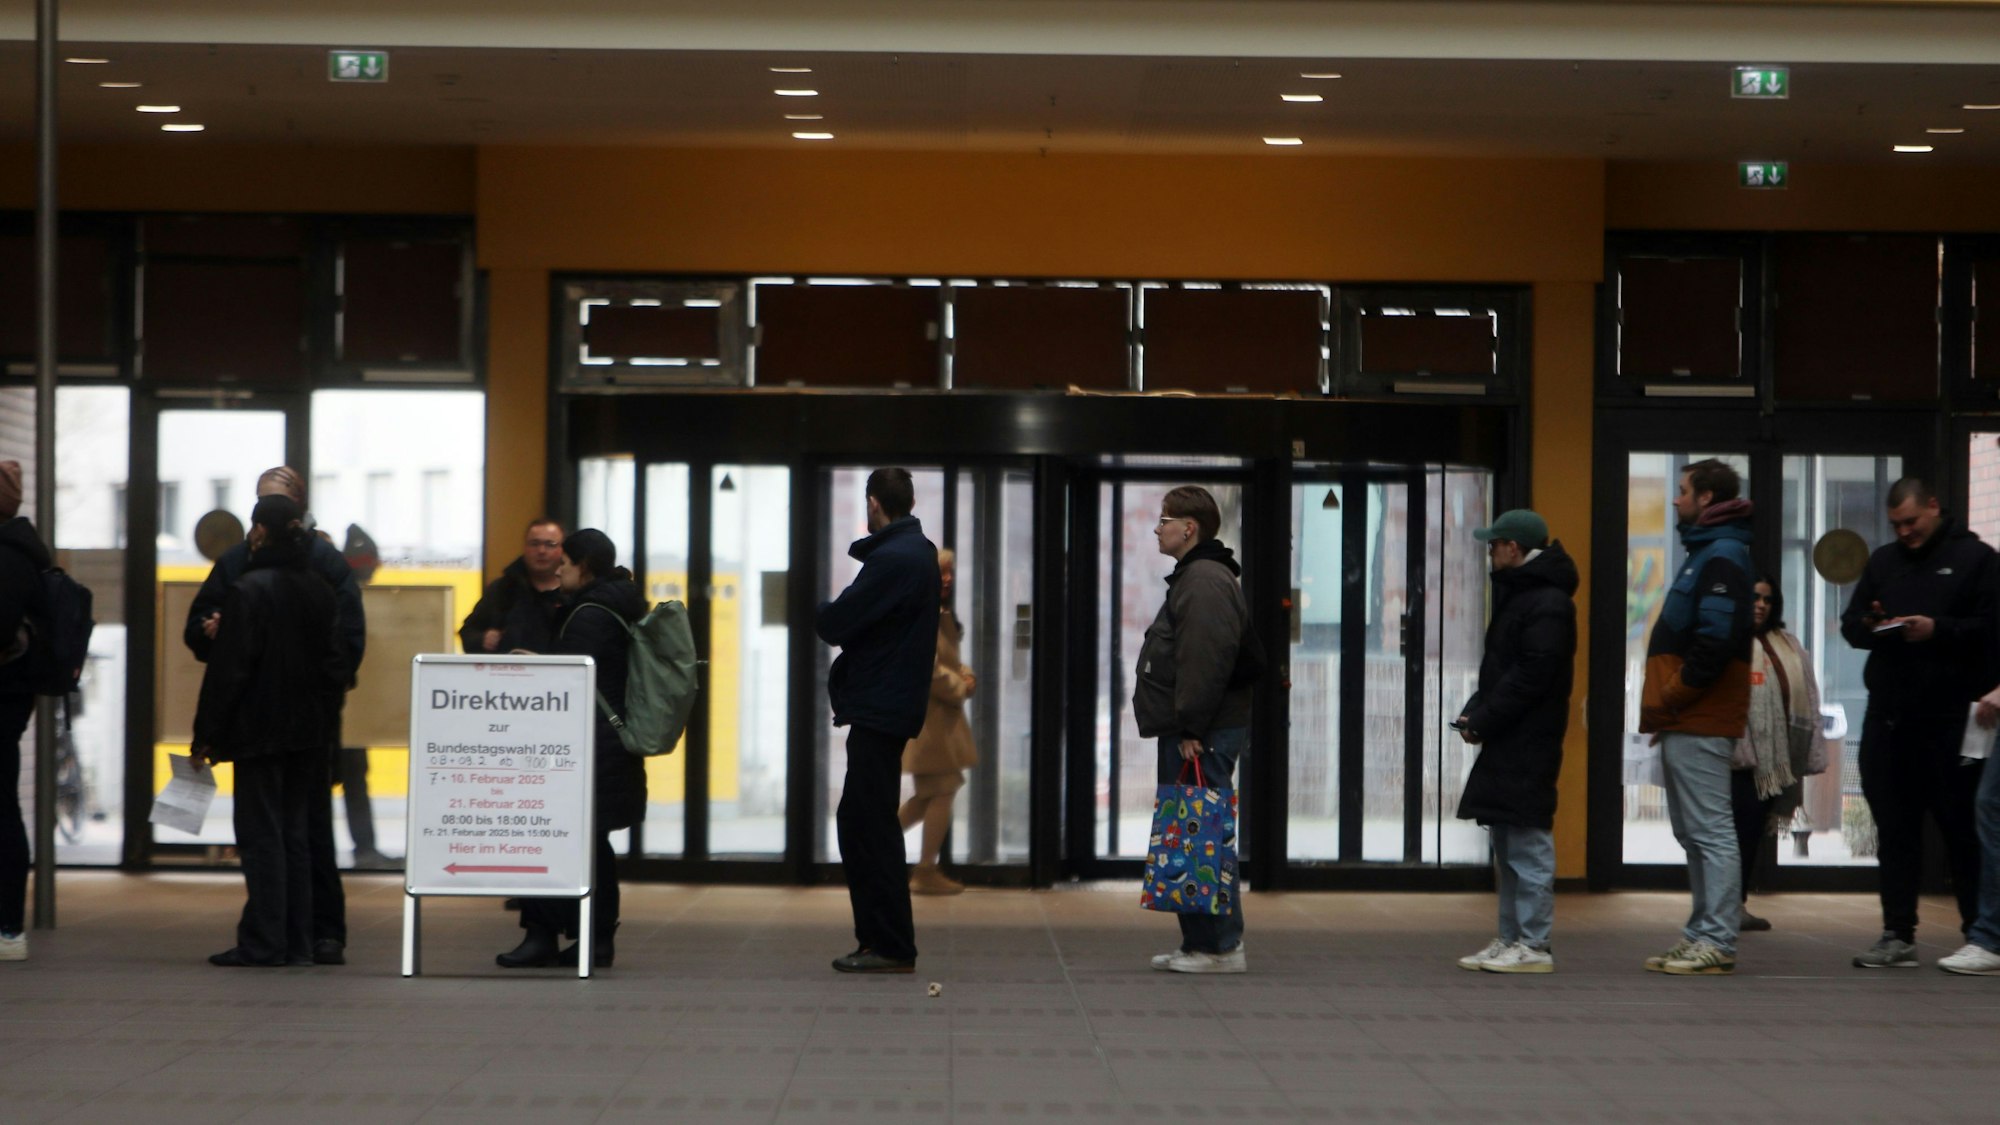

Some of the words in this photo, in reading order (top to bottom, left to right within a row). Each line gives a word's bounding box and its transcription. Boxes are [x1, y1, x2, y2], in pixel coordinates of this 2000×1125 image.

[431, 689, 569, 712] Direktwahl
[488, 723, 510, 732] zur
[427, 742, 536, 756] Bundestagswahl
[540, 744, 571, 756] 2025
[555, 758, 577, 768] Uhr
[451, 773, 466, 784] 10.
[470, 773, 515, 784] Februar
[518, 775, 545, 785] 2025
[491, 787, 504, 795] bis
[449, 799, 466, 809] 21.
[469, 799, 514, 809] Februar
[517, 800, 545, 809] 2025
[441, 815, 473, 825] 08:00
[476, 815, 493, 825] bis
[497, 816, 527, 826] 18:00
[531, 816, 552, 826] Uhr
[423, 828, 435, 836] Fr.
[437, 828, 448, 837] 21.
[452, 828, 487, 837] Februar
[488, 829, 510, 837] 2025
[511, 829, 524, 837] bis
[527, 829, 551, 838] 15:00
[553, 829, 569, 838] Uhr
[449, 842, 475, 854] Hier
[479, 842, 495, 854] im
[499, 843, 543, 855] Karree
